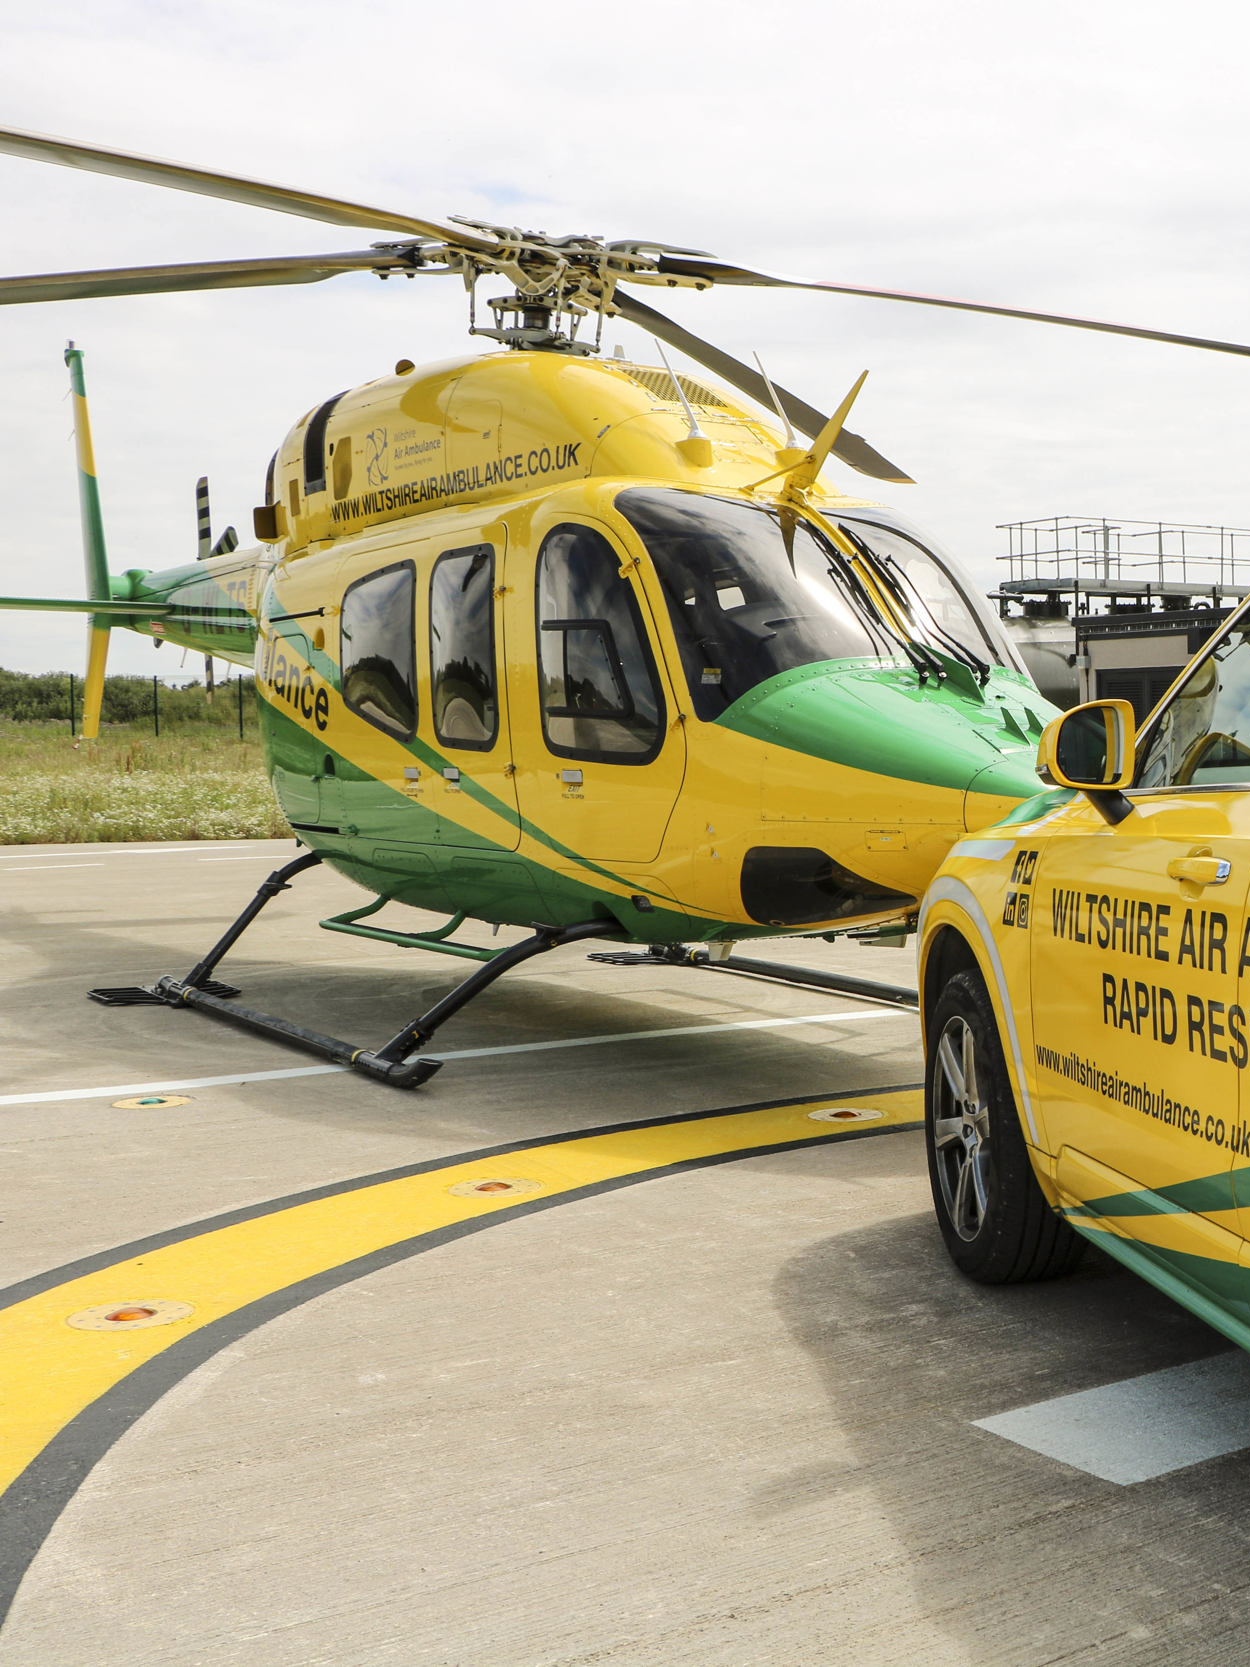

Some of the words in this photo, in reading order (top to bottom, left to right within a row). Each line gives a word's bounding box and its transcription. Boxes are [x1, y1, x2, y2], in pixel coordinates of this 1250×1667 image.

[331, 442, 580, 523] WWW.WILTSHIREAIRAMBULANCE.CO.UK
[394, 447, 403, 460] Air
[405, 439, 441, 457] Ambulance
[1052, 887, 1170, 962] WILTSHIRE
[1177, 907, 1229, 975] AIR
[1102, 972, 1178, 1047] RAPID
